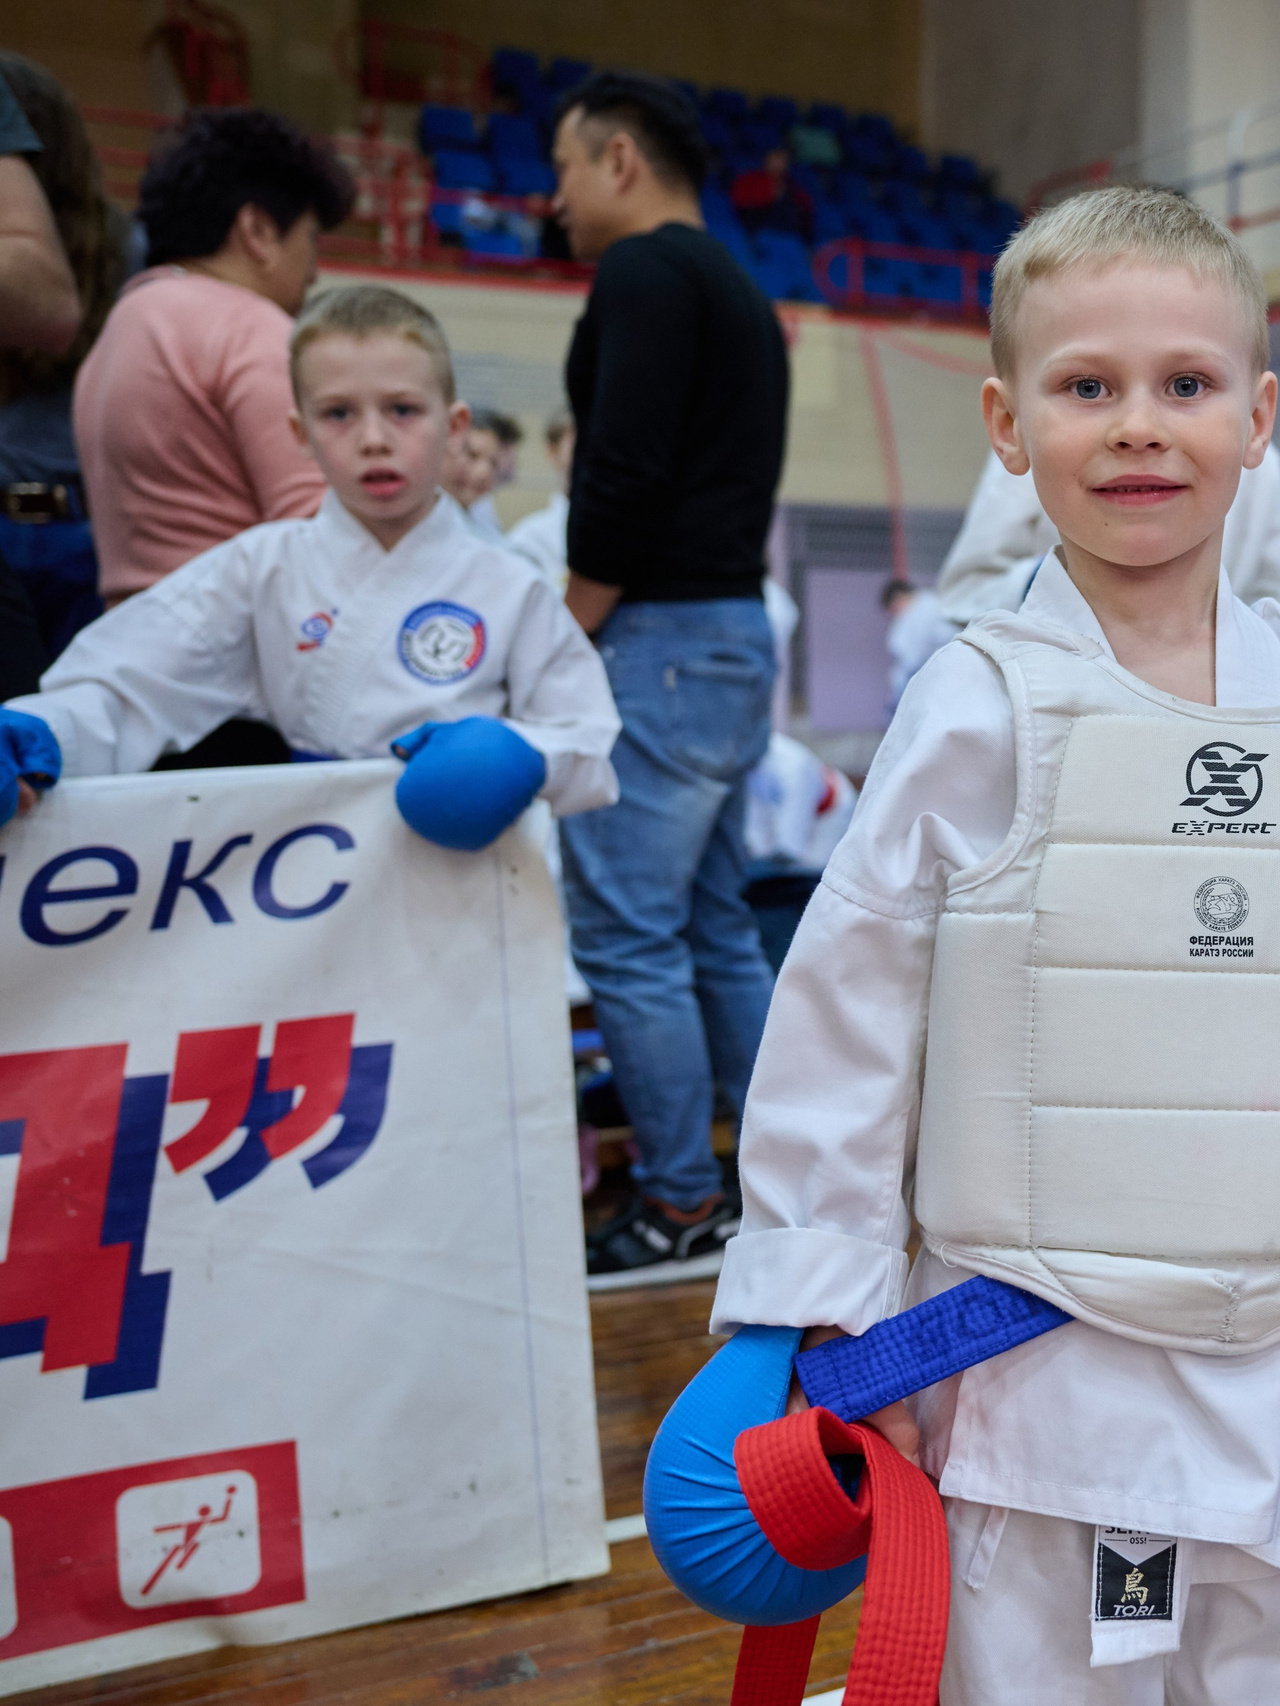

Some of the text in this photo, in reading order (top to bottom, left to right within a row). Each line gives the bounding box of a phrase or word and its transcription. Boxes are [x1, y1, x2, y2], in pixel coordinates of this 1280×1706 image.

[1171, 820, 1277, 836] EXPERT
[0, 821, 356, 948] екс
[1189, 935, 1254, 947] ФЕДЕРАЦИЯ
[1189, 948, 1254, 957] КАРАТЭ РОССИИ
[1113, 1604, 1155, 1617] TORI
